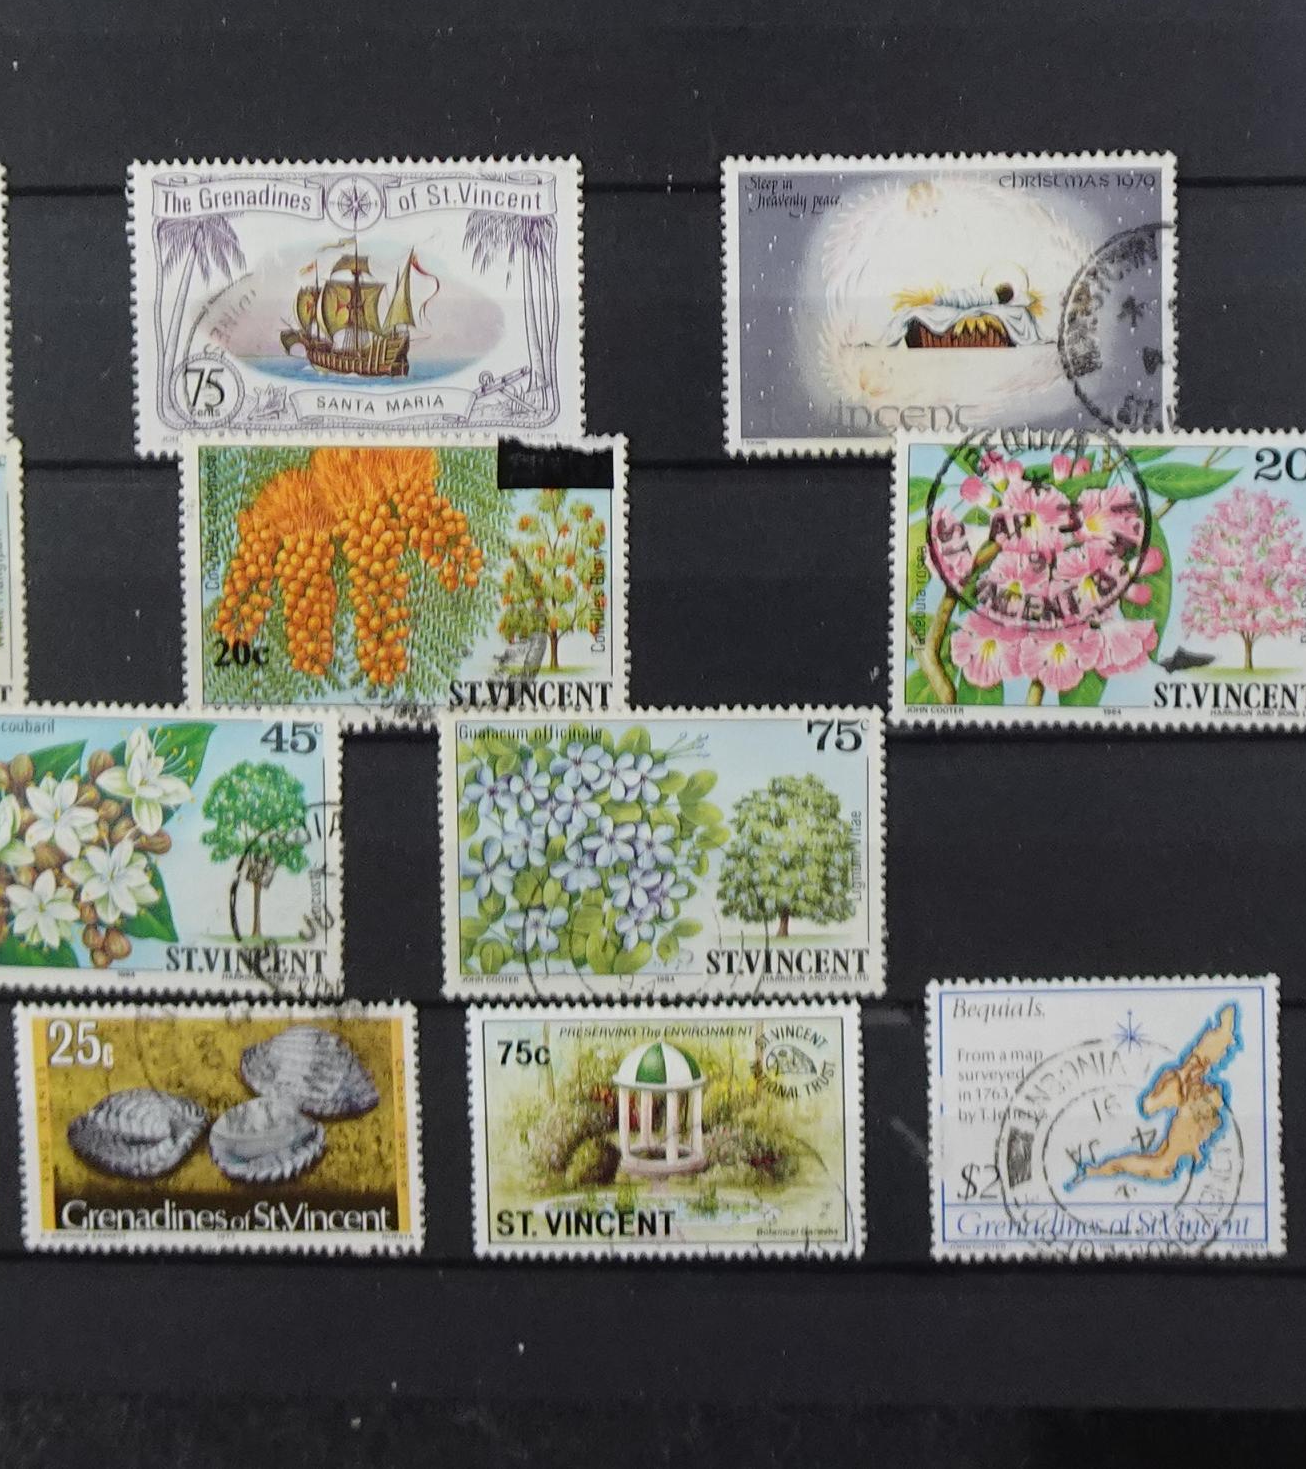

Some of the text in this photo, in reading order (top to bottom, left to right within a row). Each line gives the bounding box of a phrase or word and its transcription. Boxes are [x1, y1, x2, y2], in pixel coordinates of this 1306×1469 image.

[745, 176, 793, 195] Sleep in
[1116, 174, 1156, 189] 1979
[162, 188, 192, 214] The
[199, 182, 312, 213] Grenadines
[399, 186, 418, 211] of
[755, 191, 808, 218] heavenly
[183, 366, 226, 408] 75
[316, 393, 445, 413] SANTA MARIA
[213, 639, 270, 667] 20c
[952, 996, 1024, 1024] Bequia
[47, 1018, 115, 1069] 25c
[559, 1025, 638, 1039] PRESERVING
[663, 1024, 755, 1039] ENVIRONMENT
[773, 1024, 830, 1050] VINCENT
[497, 1039, 551, 1066] 75c
[956, 1047, 1044, 1067] From a map
[957, 1067, 1027, 1087] surveyed
[958, 1087, 971, 1102] in
[957, 1107, 977, 1124] by
[956, 1161, 1000, 1201] $2
[61, 1198, 228, 1231] Grenadines
[230, 1209, 251, 1231] of
[496, 1210, 676, 1238] ST. VINCENT
